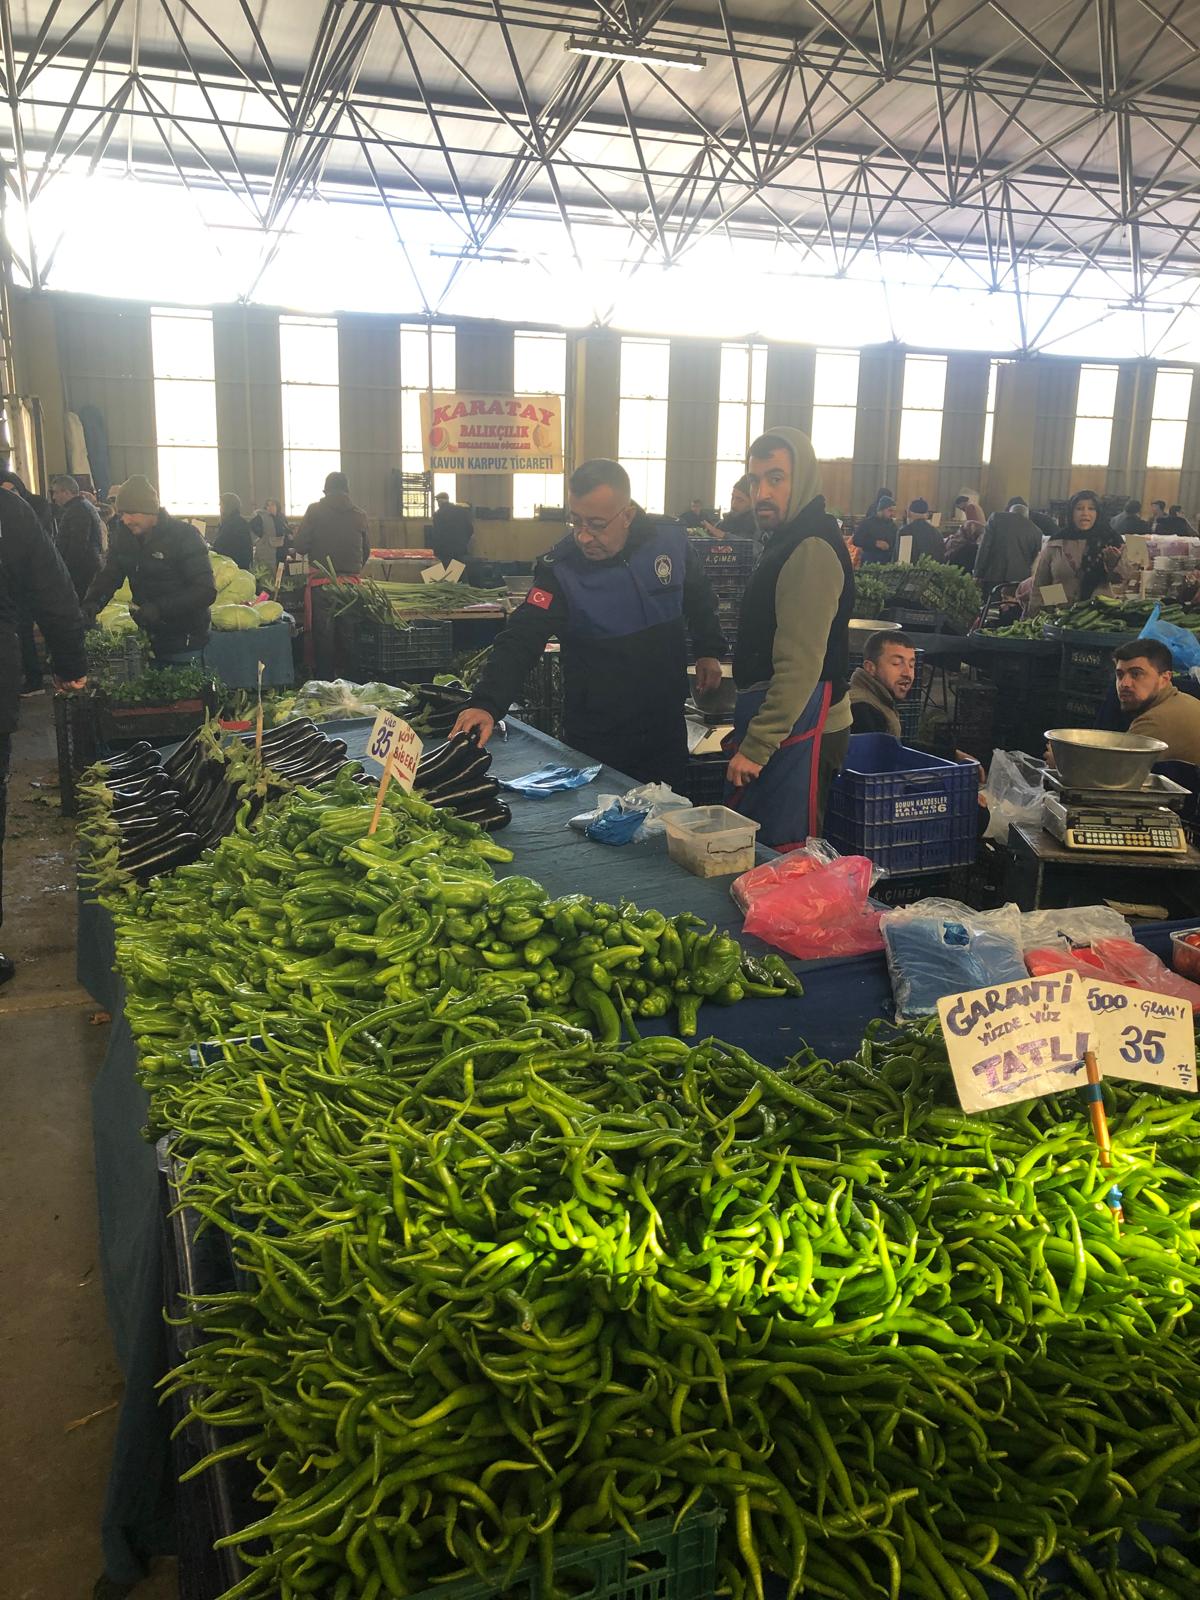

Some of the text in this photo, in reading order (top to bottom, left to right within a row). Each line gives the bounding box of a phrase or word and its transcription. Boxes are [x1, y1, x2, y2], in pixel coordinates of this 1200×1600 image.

[432, 400, 555, 426] KARATAY
[460, 425, 529, 440] BALIKÇILIK
[430, 454, 553, 470] KAVUN KARPUZ TİCARETİ
[371, 726, 394, 758] 35
[937, 803, 947, 813] 6
[946, 973, 1073, 1037] GARANTİ
[1086, 987, 1128, 1011] 500
[977, 1003, 1061, 1046] YÜZDE YÜZ
[972, 1031, 1090, 1087] TATLI
[1119, 1025, 1166, 1065] 35
